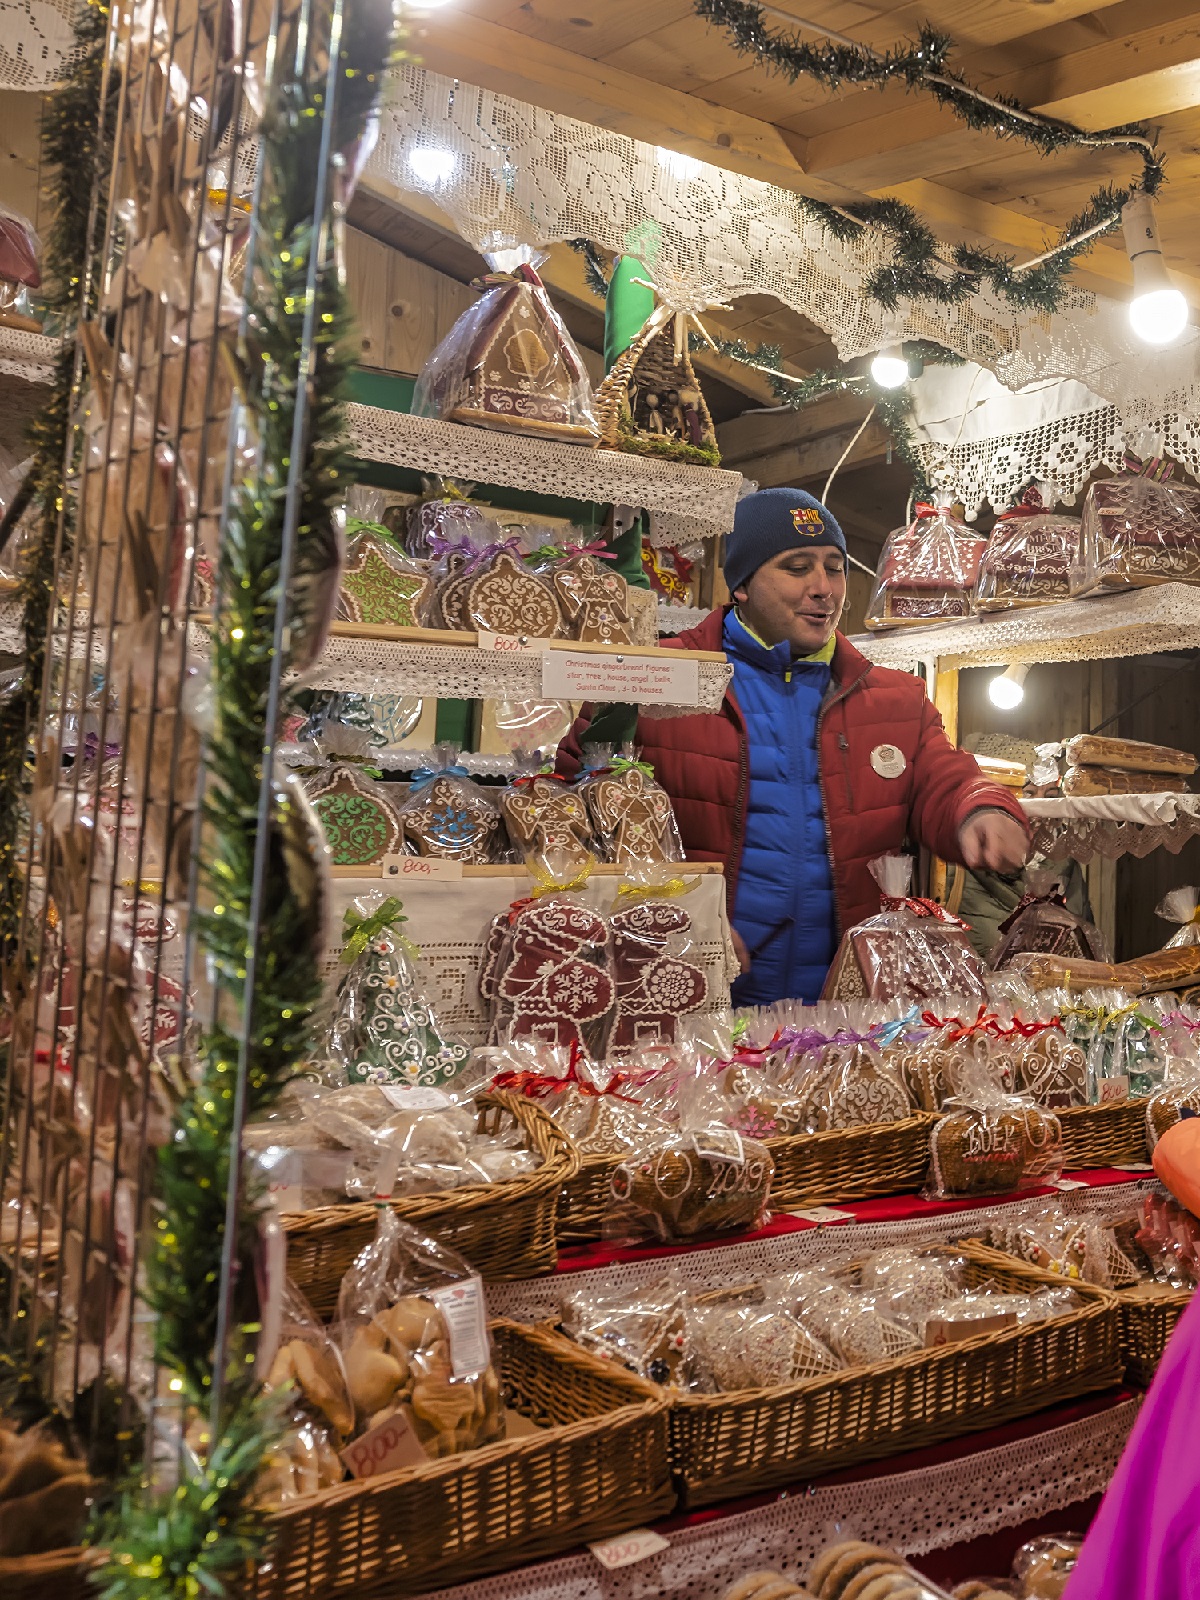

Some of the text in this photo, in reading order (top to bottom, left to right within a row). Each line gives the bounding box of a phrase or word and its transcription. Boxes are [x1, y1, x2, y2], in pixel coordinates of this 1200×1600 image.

[565, 660, 601, 669] Christmas
[601, 662, 644, 672] gingerbread
[576, 683, 597, 691] Santa
[706, 1160, 766, 1195] 2019
